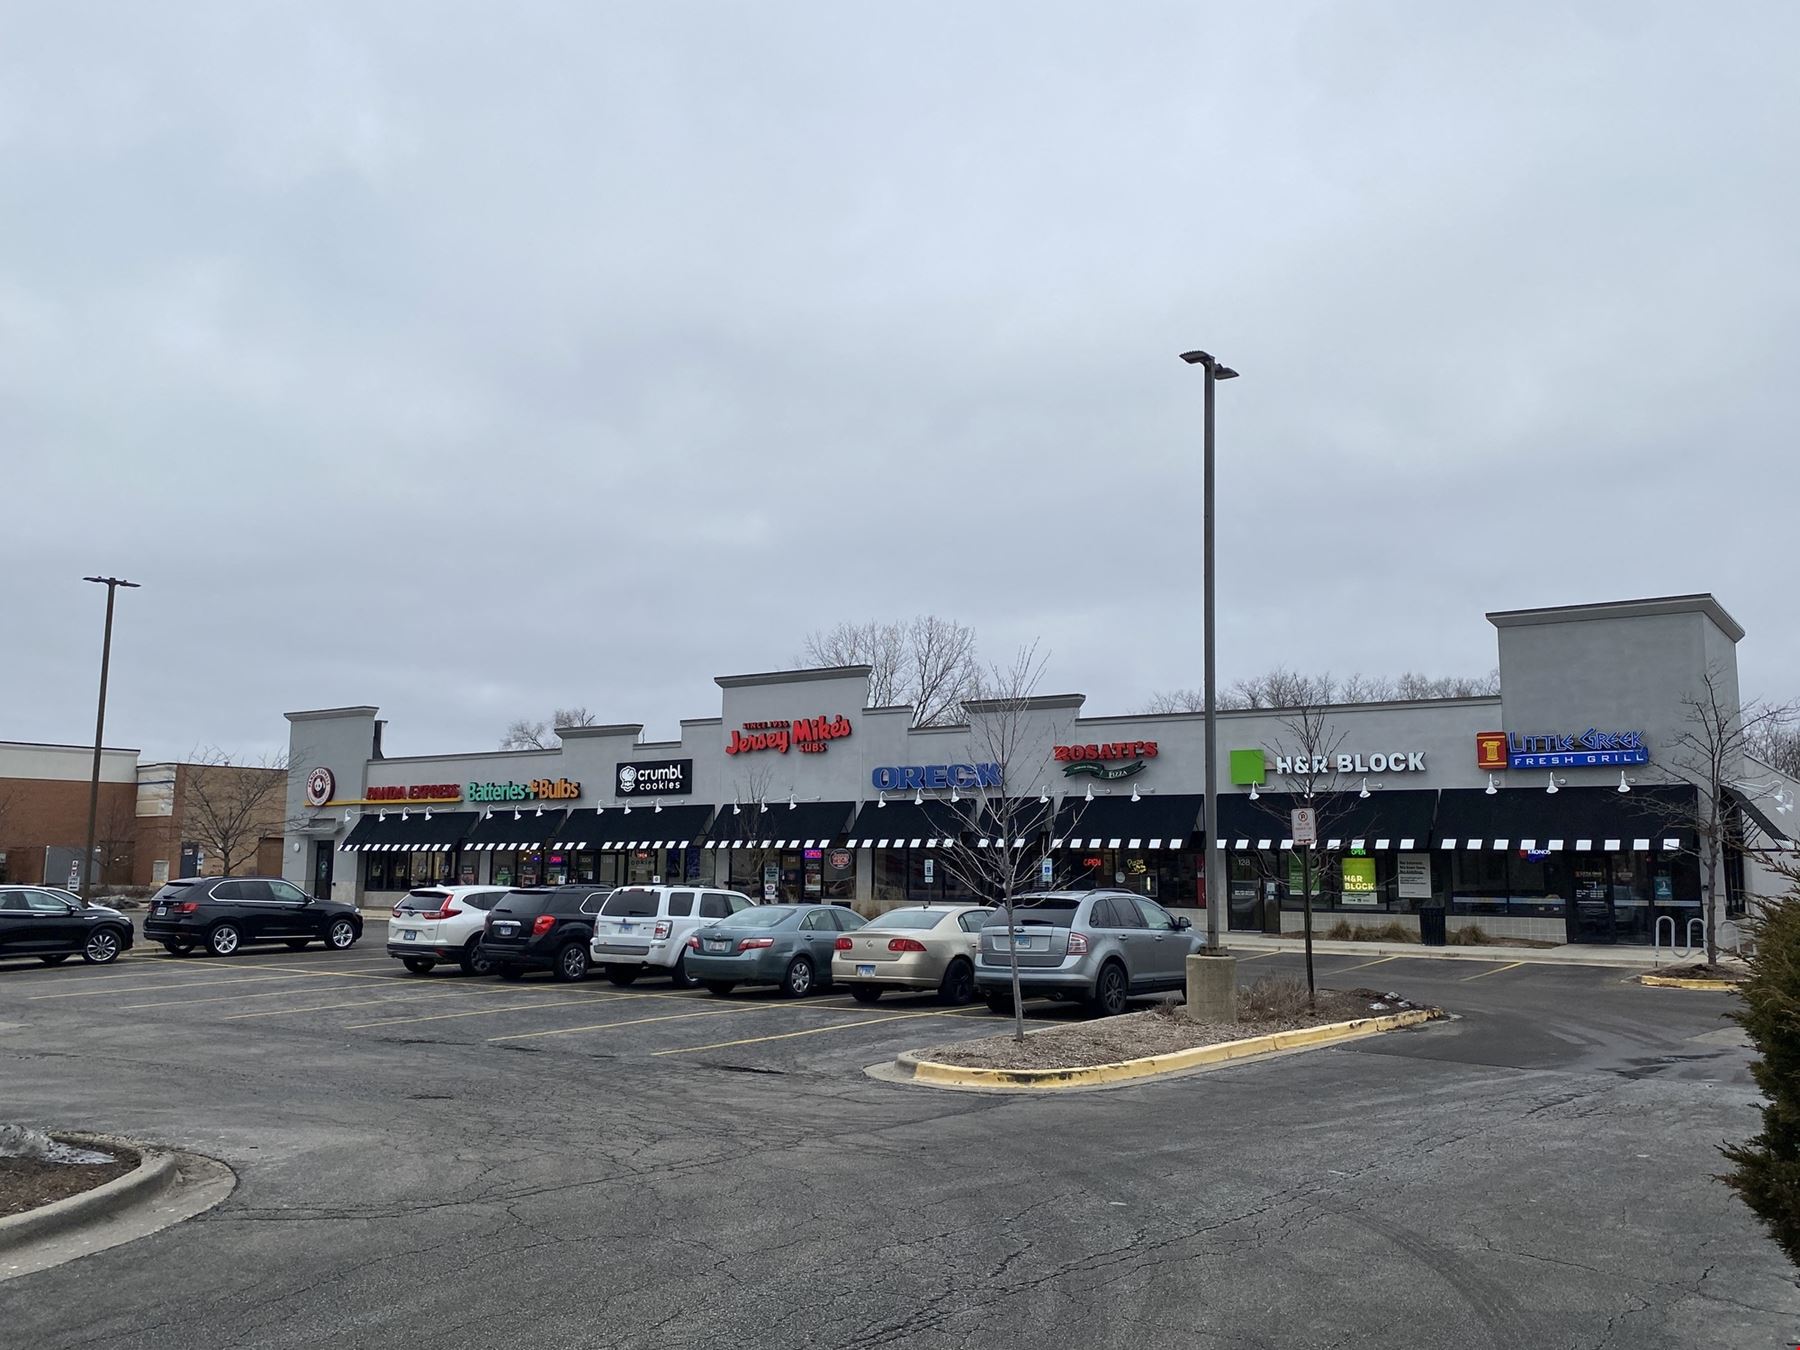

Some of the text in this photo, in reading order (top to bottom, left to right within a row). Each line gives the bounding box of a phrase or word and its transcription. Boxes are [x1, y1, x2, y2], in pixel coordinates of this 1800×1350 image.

[725, 714, 853, 756] Jersey Mike's
[799, 743, 828, 753] SUBS
[1053, 741, 1158, 761] ROSATI'S
[1275, 751, 1427, 775] H&R BLOCK
[1514, 753, 1645, 766] FRESH GRILL
[637, 764, 683, 781] crumbl
[872, 762, 1003, 790] ORECK
[639, 780, 681, 791] cookies
[1343, 874, 1364, 883] H&R
[1344, 882, 1375, 891] BLOCK
